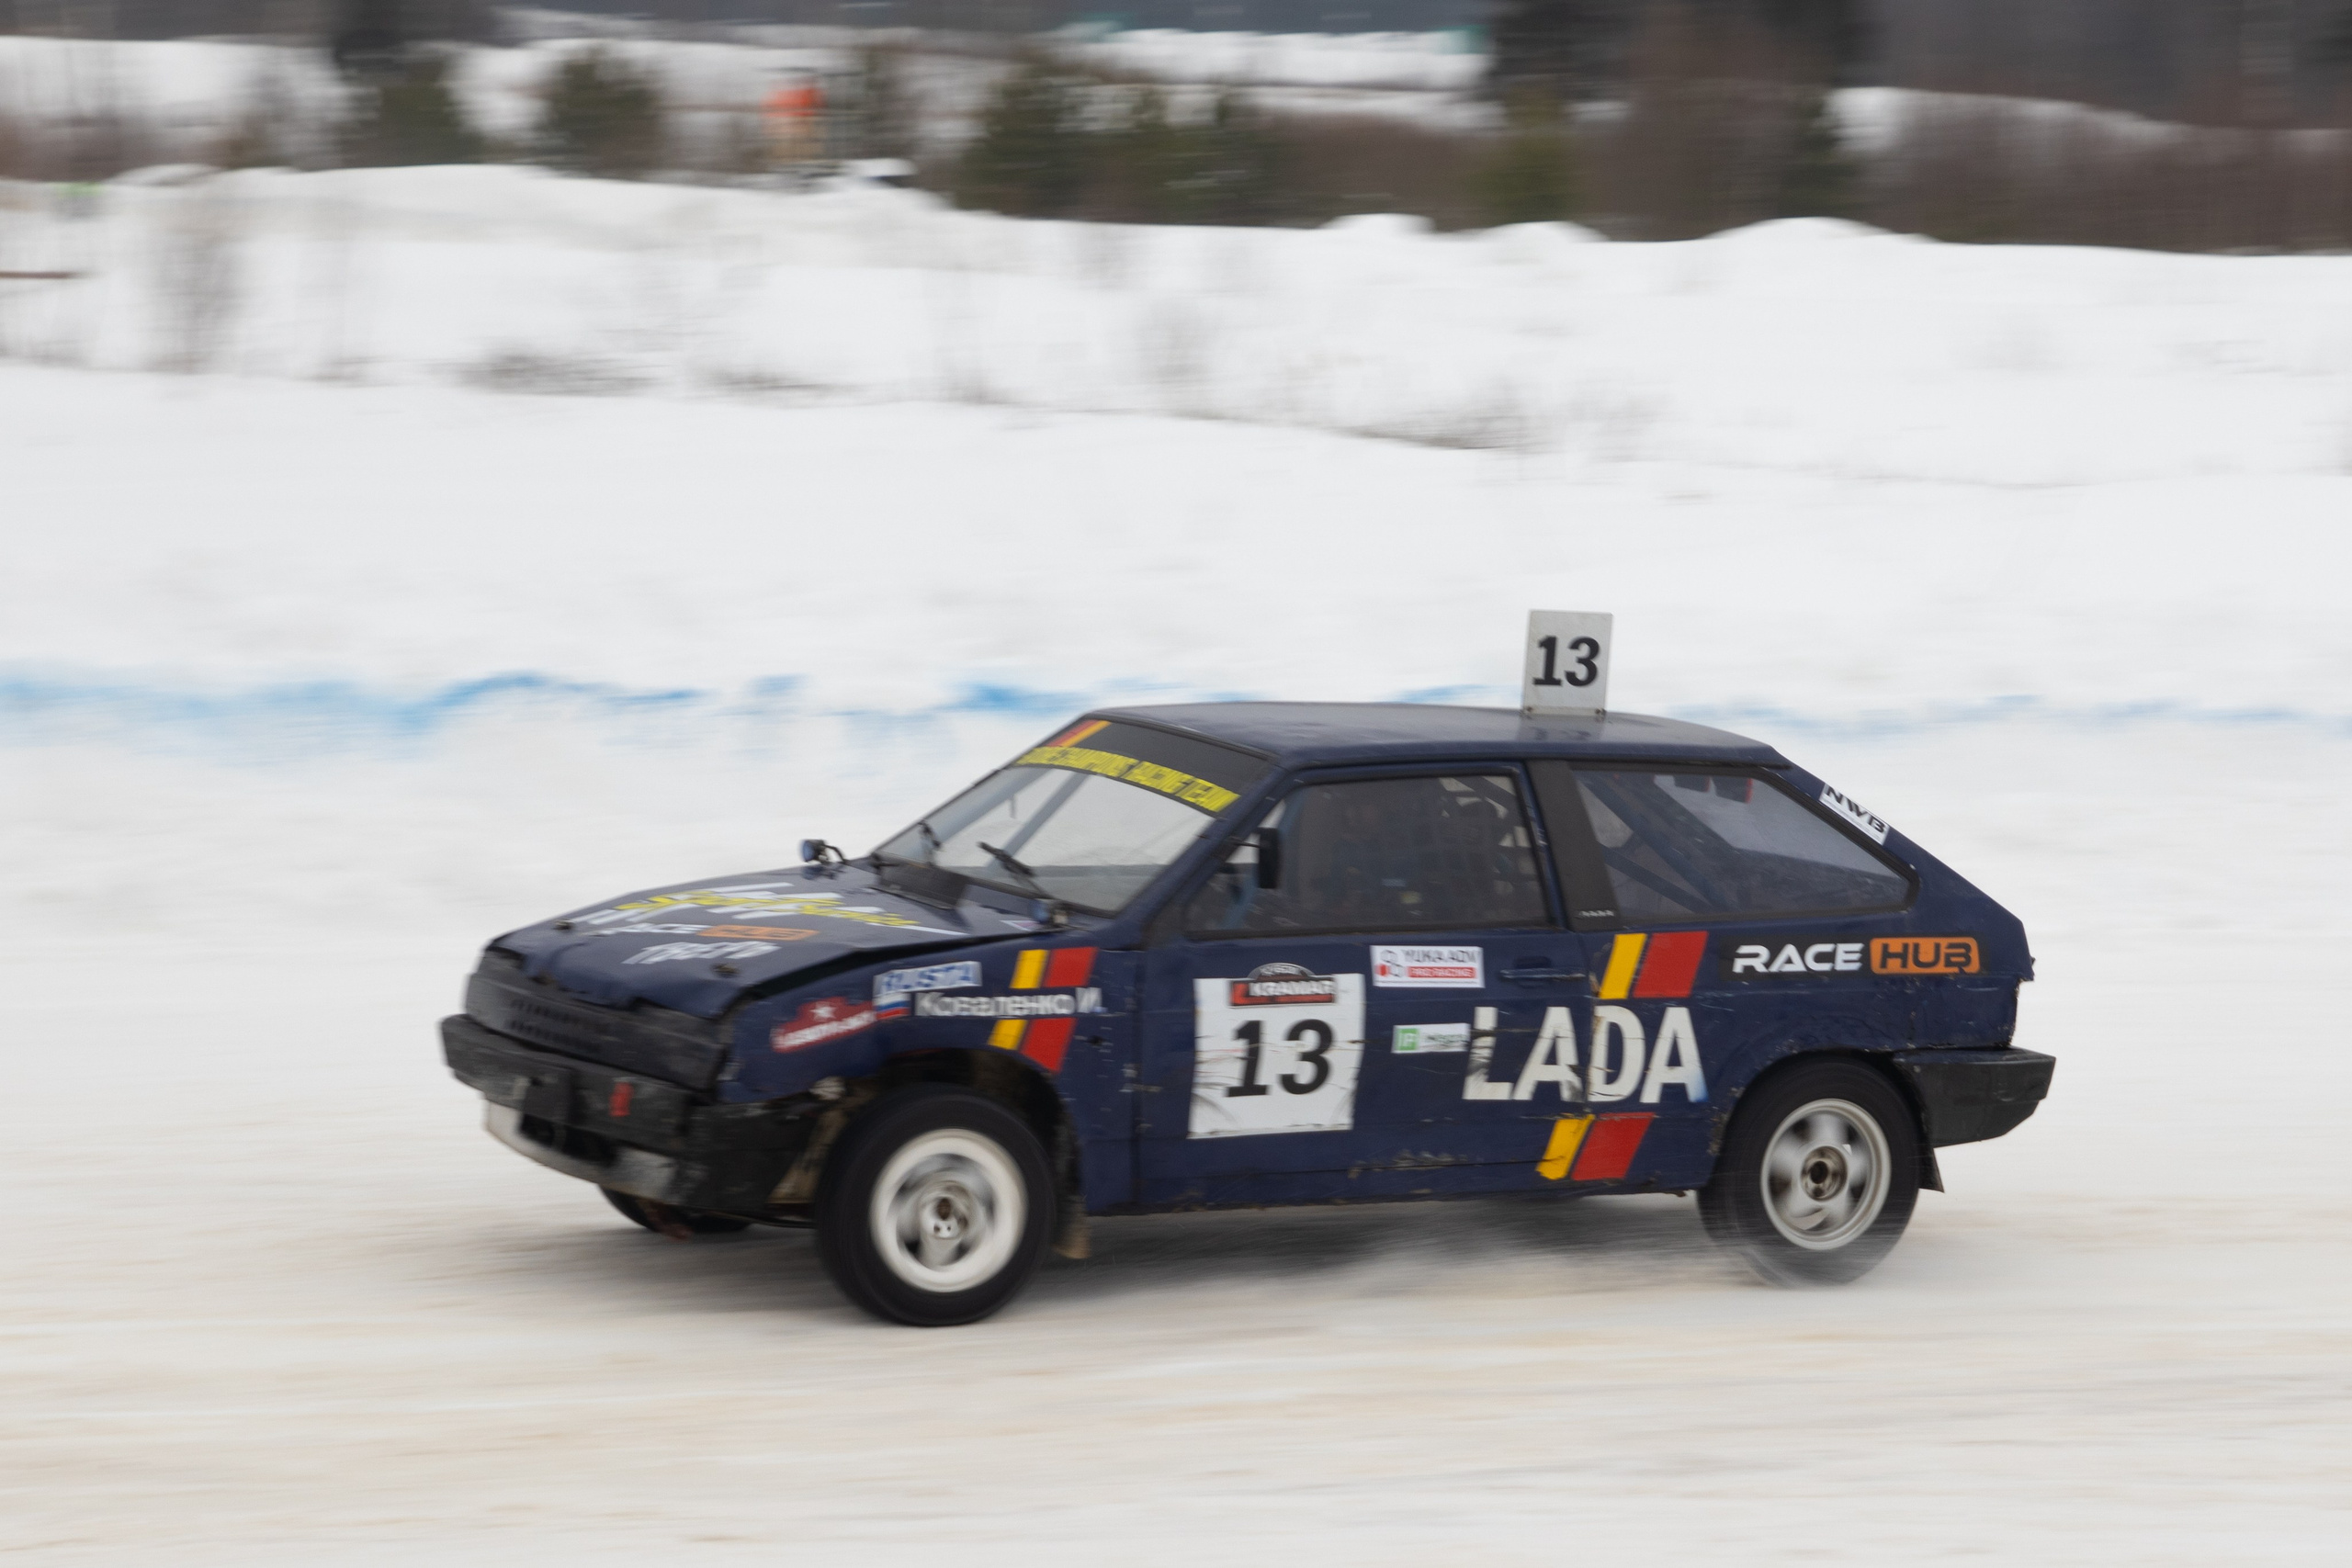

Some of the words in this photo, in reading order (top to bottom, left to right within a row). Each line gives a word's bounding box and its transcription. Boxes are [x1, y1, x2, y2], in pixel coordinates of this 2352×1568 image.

[1532, 635, 1600, 687] 13
[1826, 785, 1886, 833] NWB
[1732, 942, 1863, 974] RACE
[1878, 942, 1973, 972] HUB
[1224, 1018, 1335, 1098] 13
[1463, 1006, 1709, 1103] LADA
